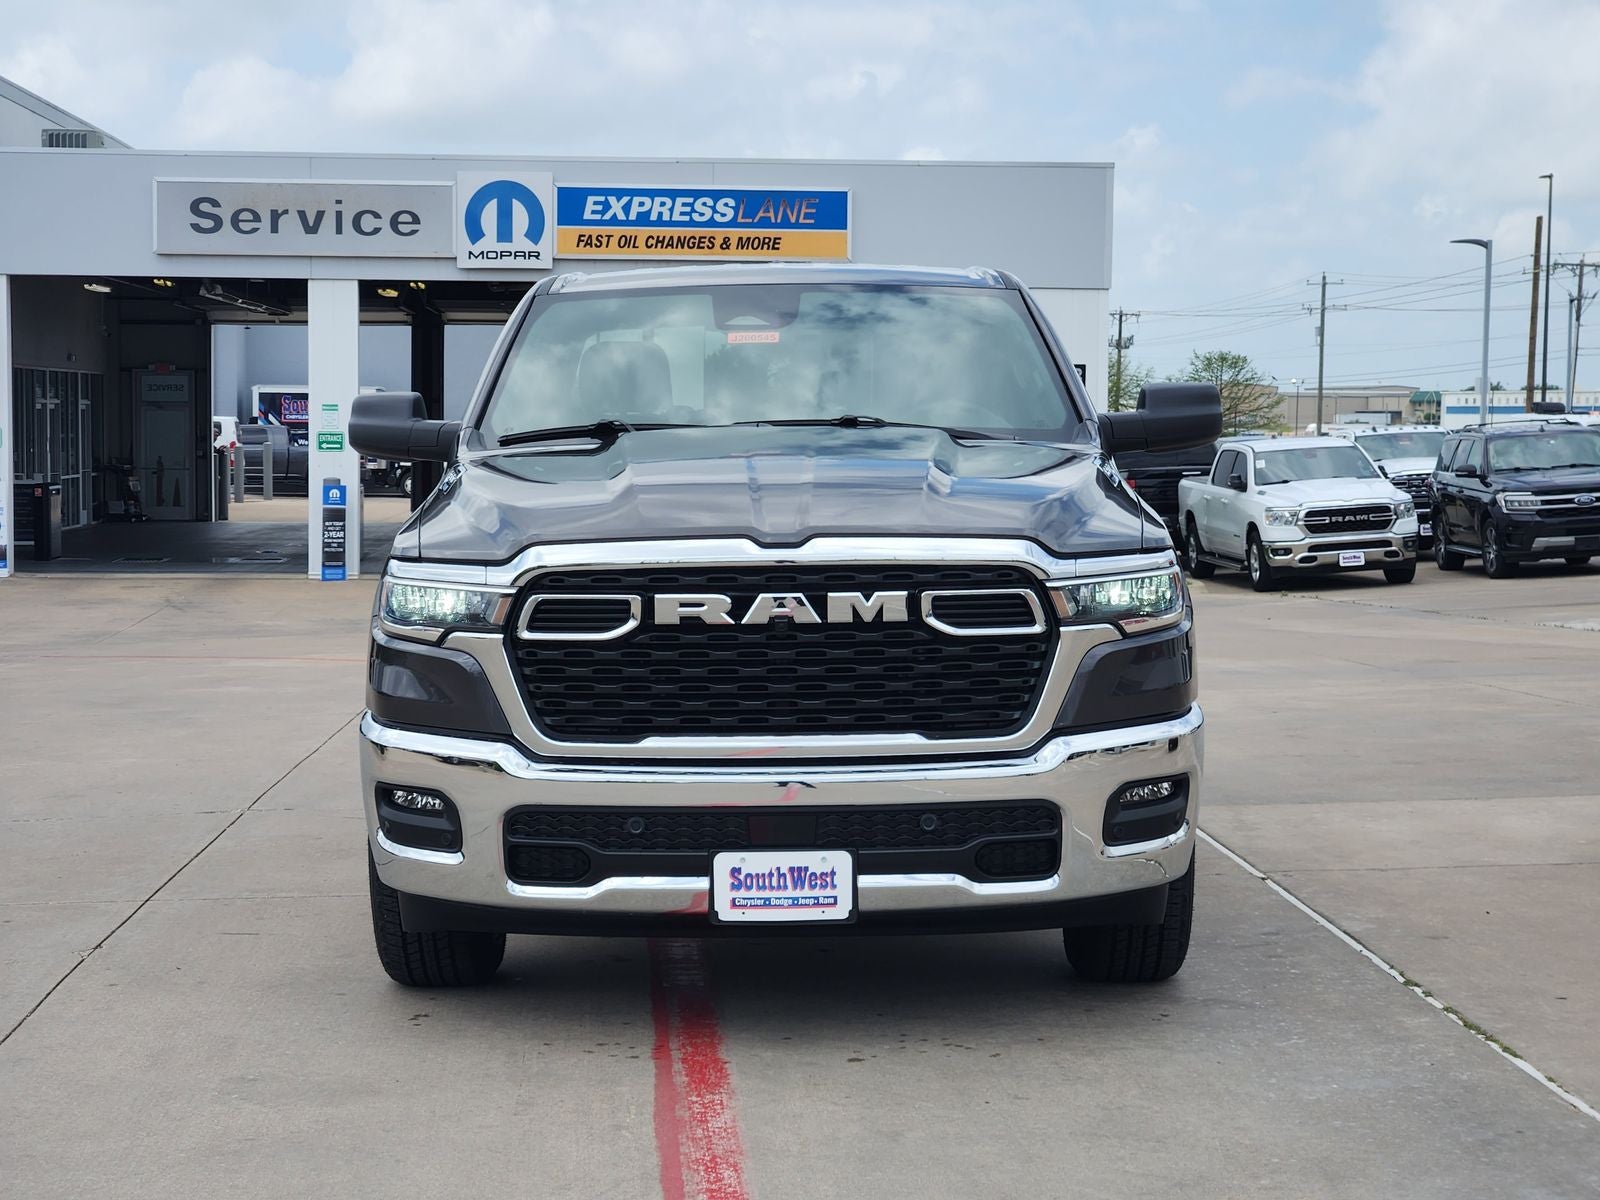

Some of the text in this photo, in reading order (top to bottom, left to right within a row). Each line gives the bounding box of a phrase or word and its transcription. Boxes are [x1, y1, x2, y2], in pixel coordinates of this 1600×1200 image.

[189, 196, 421, 237] Service
[576, 234, 782, 251] FAST OIL CHANGES & MORE
[468, 250, 542, 261] MOPAR
[319, 434, 343, 442] ENTRANCE
[1331, 514, 1369, 523] RAM
[654, 591, 908, 624] RAM
[729, 865, 837, 892] SouthWest
[735, 896, 834, 907] Chrysler Dodge Jeep Ram
